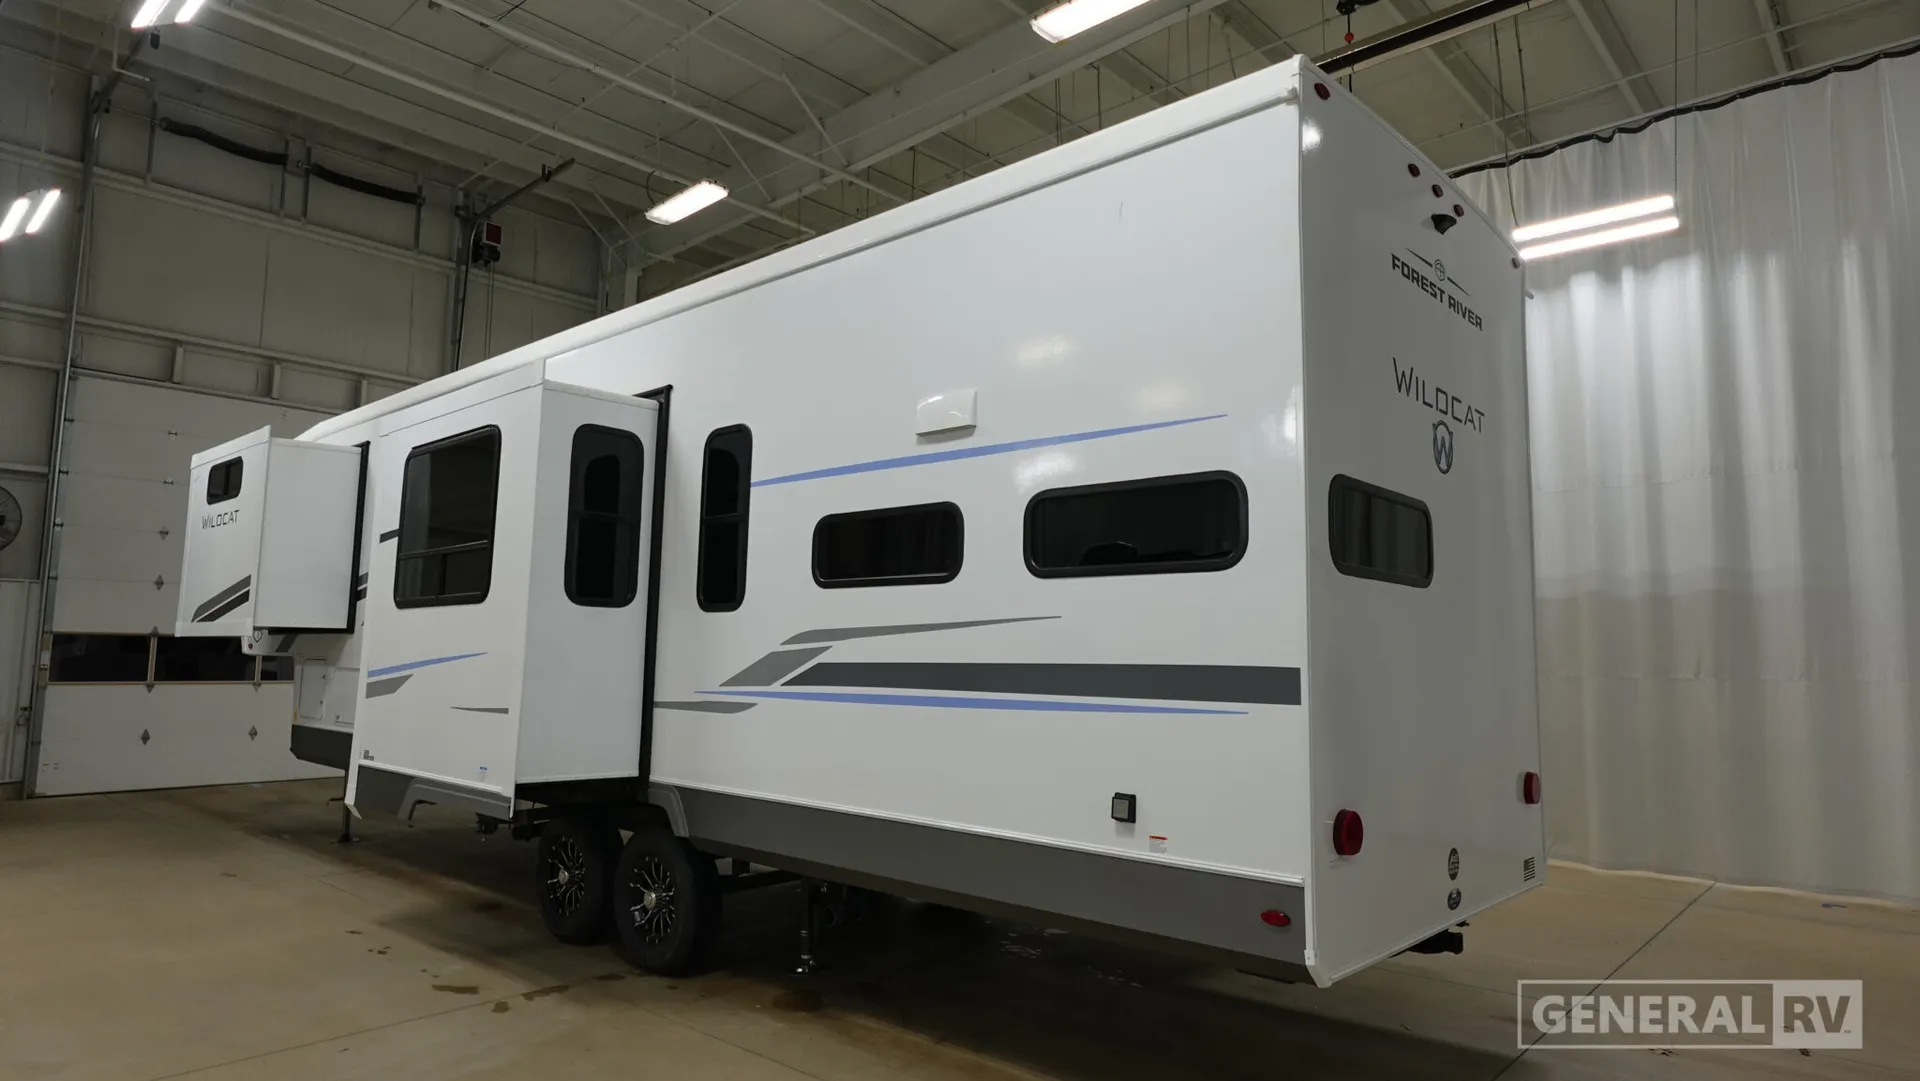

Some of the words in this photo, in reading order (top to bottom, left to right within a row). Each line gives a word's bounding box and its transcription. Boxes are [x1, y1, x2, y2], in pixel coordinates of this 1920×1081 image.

[1391, 253, 1445, 303] FOREST
[1448, 294, 1483, 331] RIVER
[1392, 357, 1485, 433] WILDCAT
[202, 509, 240, 530] WILDCAT
